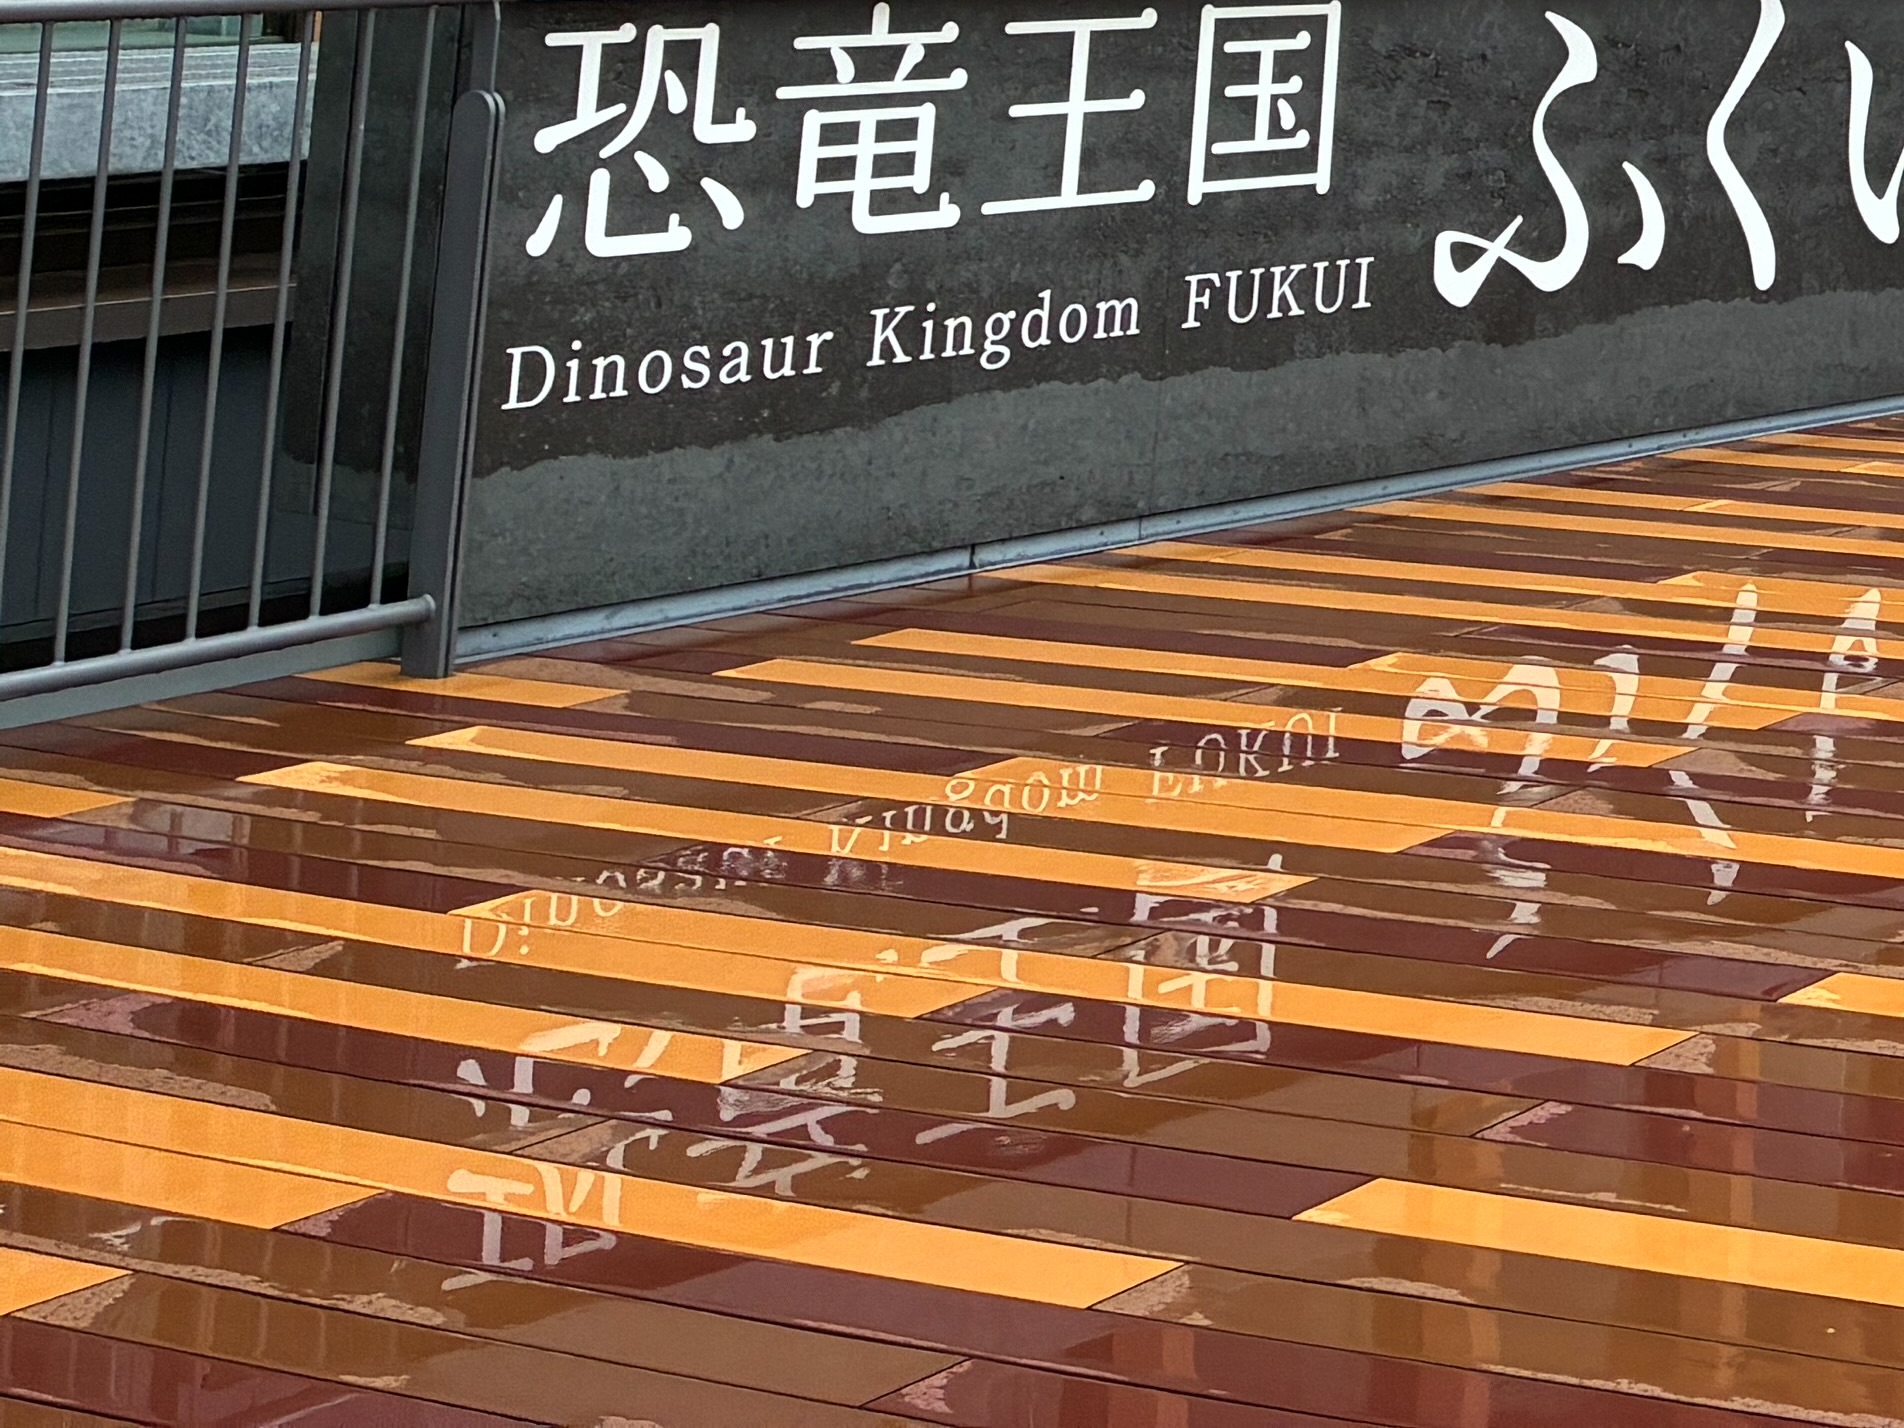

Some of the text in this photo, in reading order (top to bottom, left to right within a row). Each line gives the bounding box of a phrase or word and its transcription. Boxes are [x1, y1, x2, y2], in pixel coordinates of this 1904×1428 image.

[525, 0, 1343, 258] 恐竜王国
[500, 256, 1376, 411] Dinosaur Kingdom FUKUI
